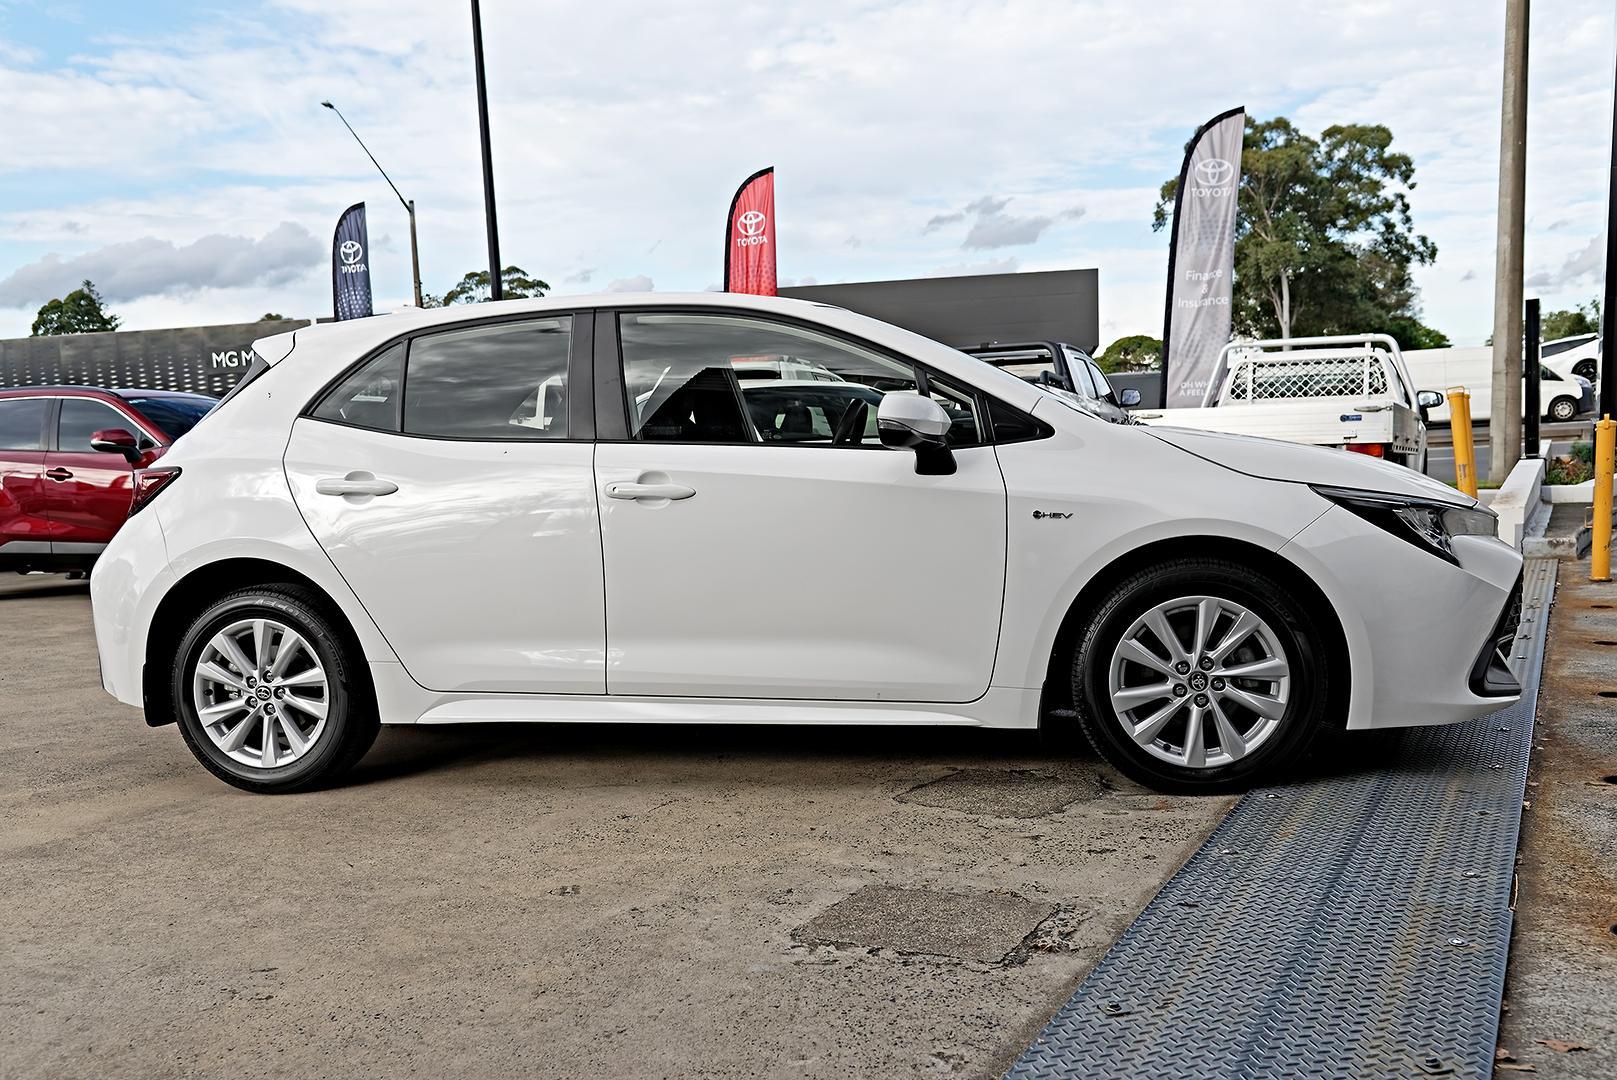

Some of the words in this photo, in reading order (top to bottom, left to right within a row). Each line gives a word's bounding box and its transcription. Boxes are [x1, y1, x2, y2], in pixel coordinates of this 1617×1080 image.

[737, 236, 768, 247] TOYOTA
[1178, 296, 1229, 308] Insurance
[211, 350, 239, 368] MG
[1042, 511, 1074, 519] HEV
